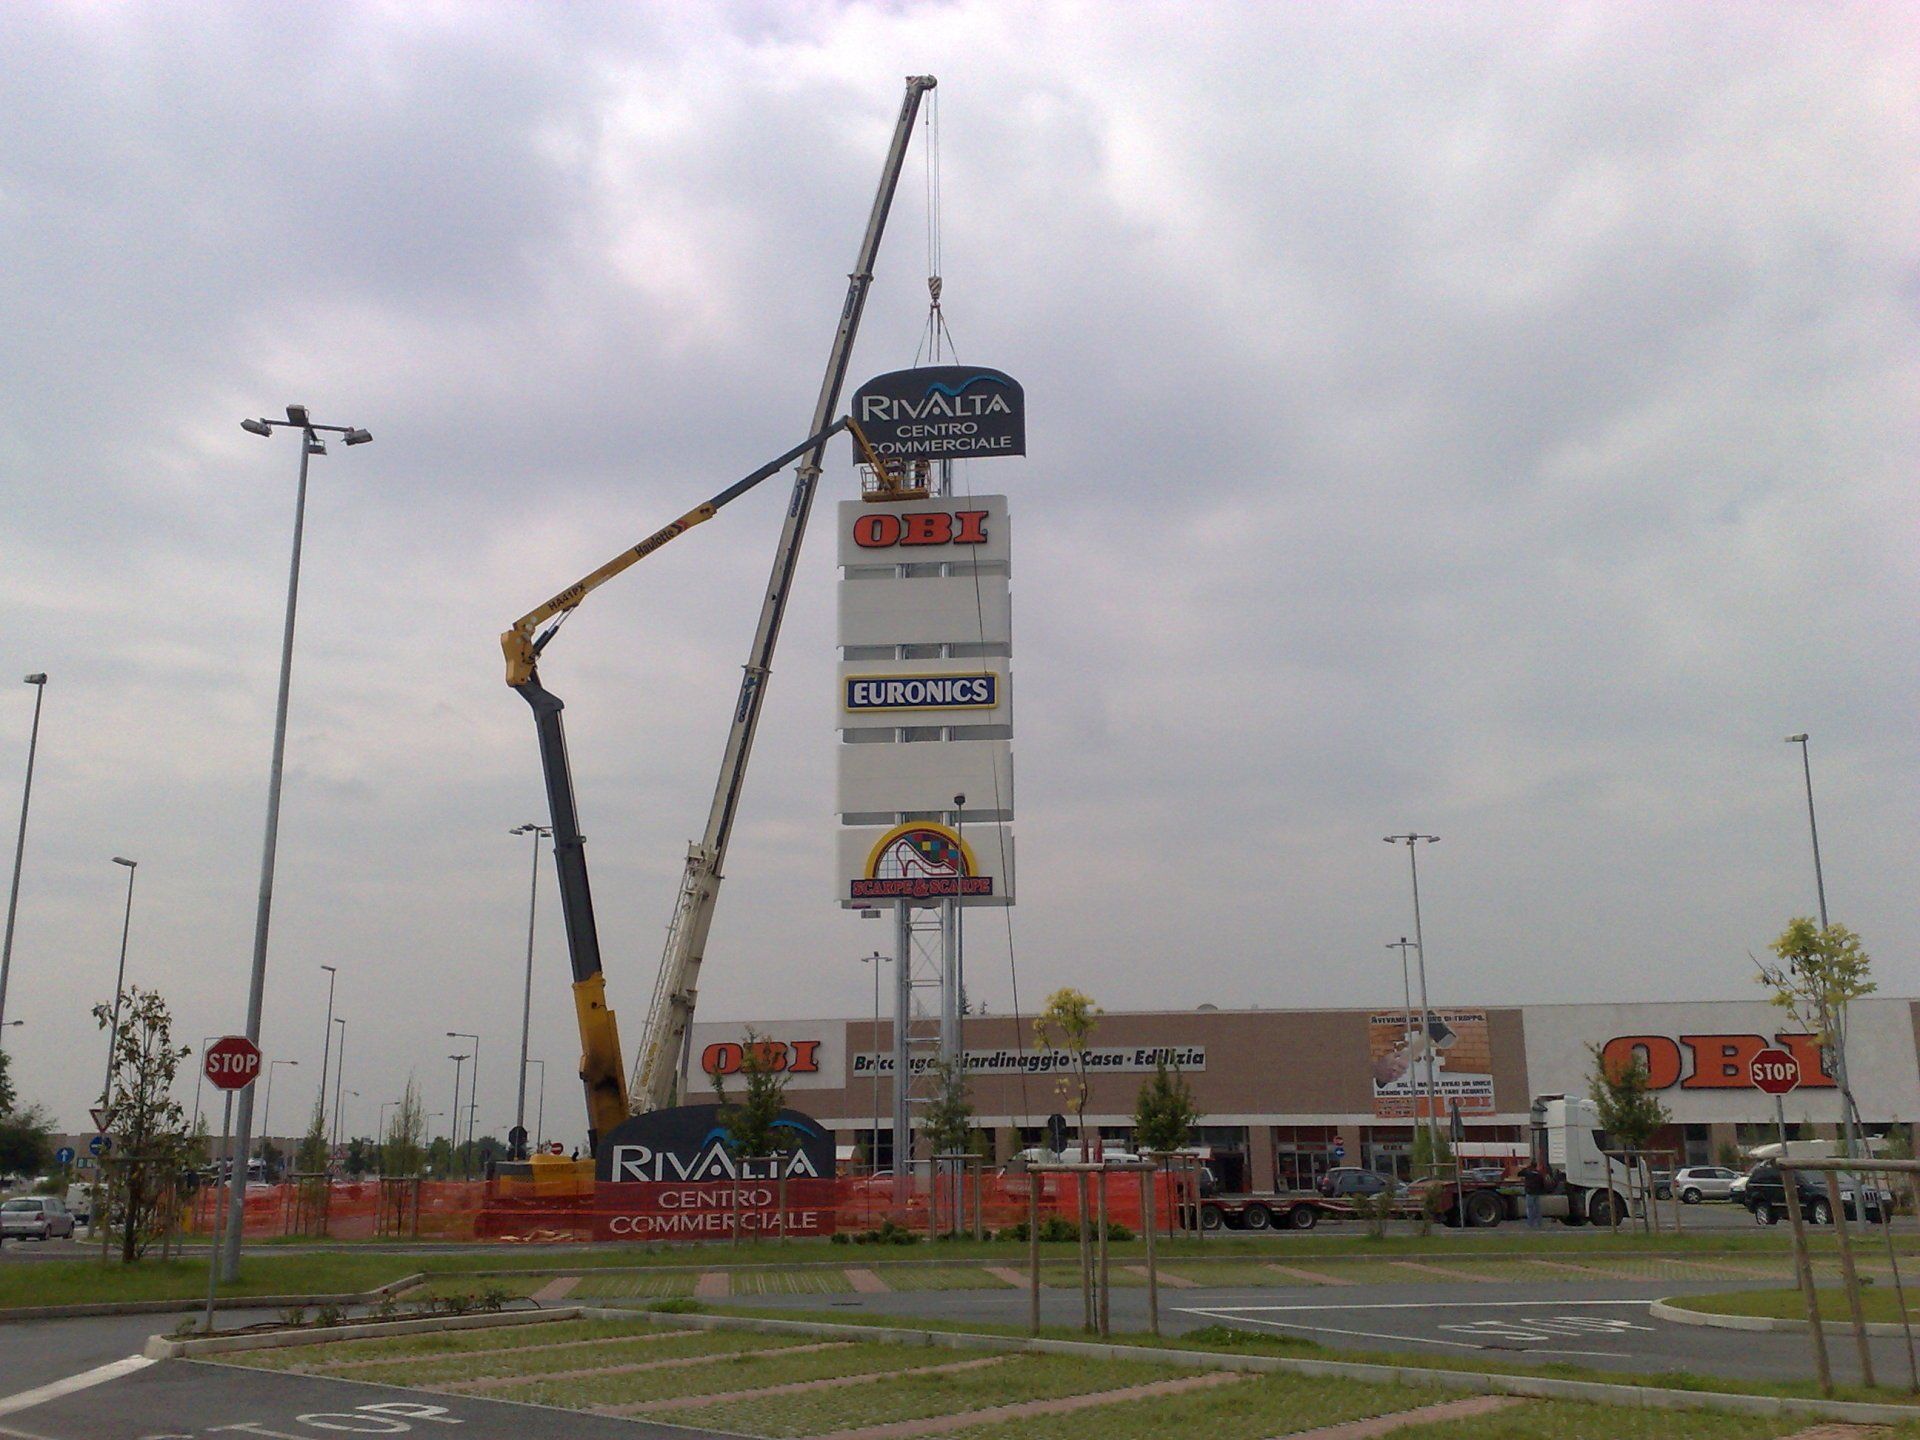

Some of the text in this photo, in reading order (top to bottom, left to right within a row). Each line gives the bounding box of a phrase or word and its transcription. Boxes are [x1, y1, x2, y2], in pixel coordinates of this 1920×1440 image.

[863, 392, 1011, 421] RIVALTA
[897, 422, 977, 437] CENTRO
[853, 510, 989, 547] OBI
[634, 527, 674, 557] Haulotte
[853, 679, 988, 704] EURONICS
[853, 878, 989, 897] SCARPE & SCARPE
[208, 1053, 257, 1073] STOP
[702, 1041, 820, 1074] OBI
[1080, 1051, 1124, 1066] Casa
[1601, 1034, 1840, 1089] OBI
[1753, 1062, 1796, 1081] STOP
[658, 1189, 772, 1209] CENTRO
